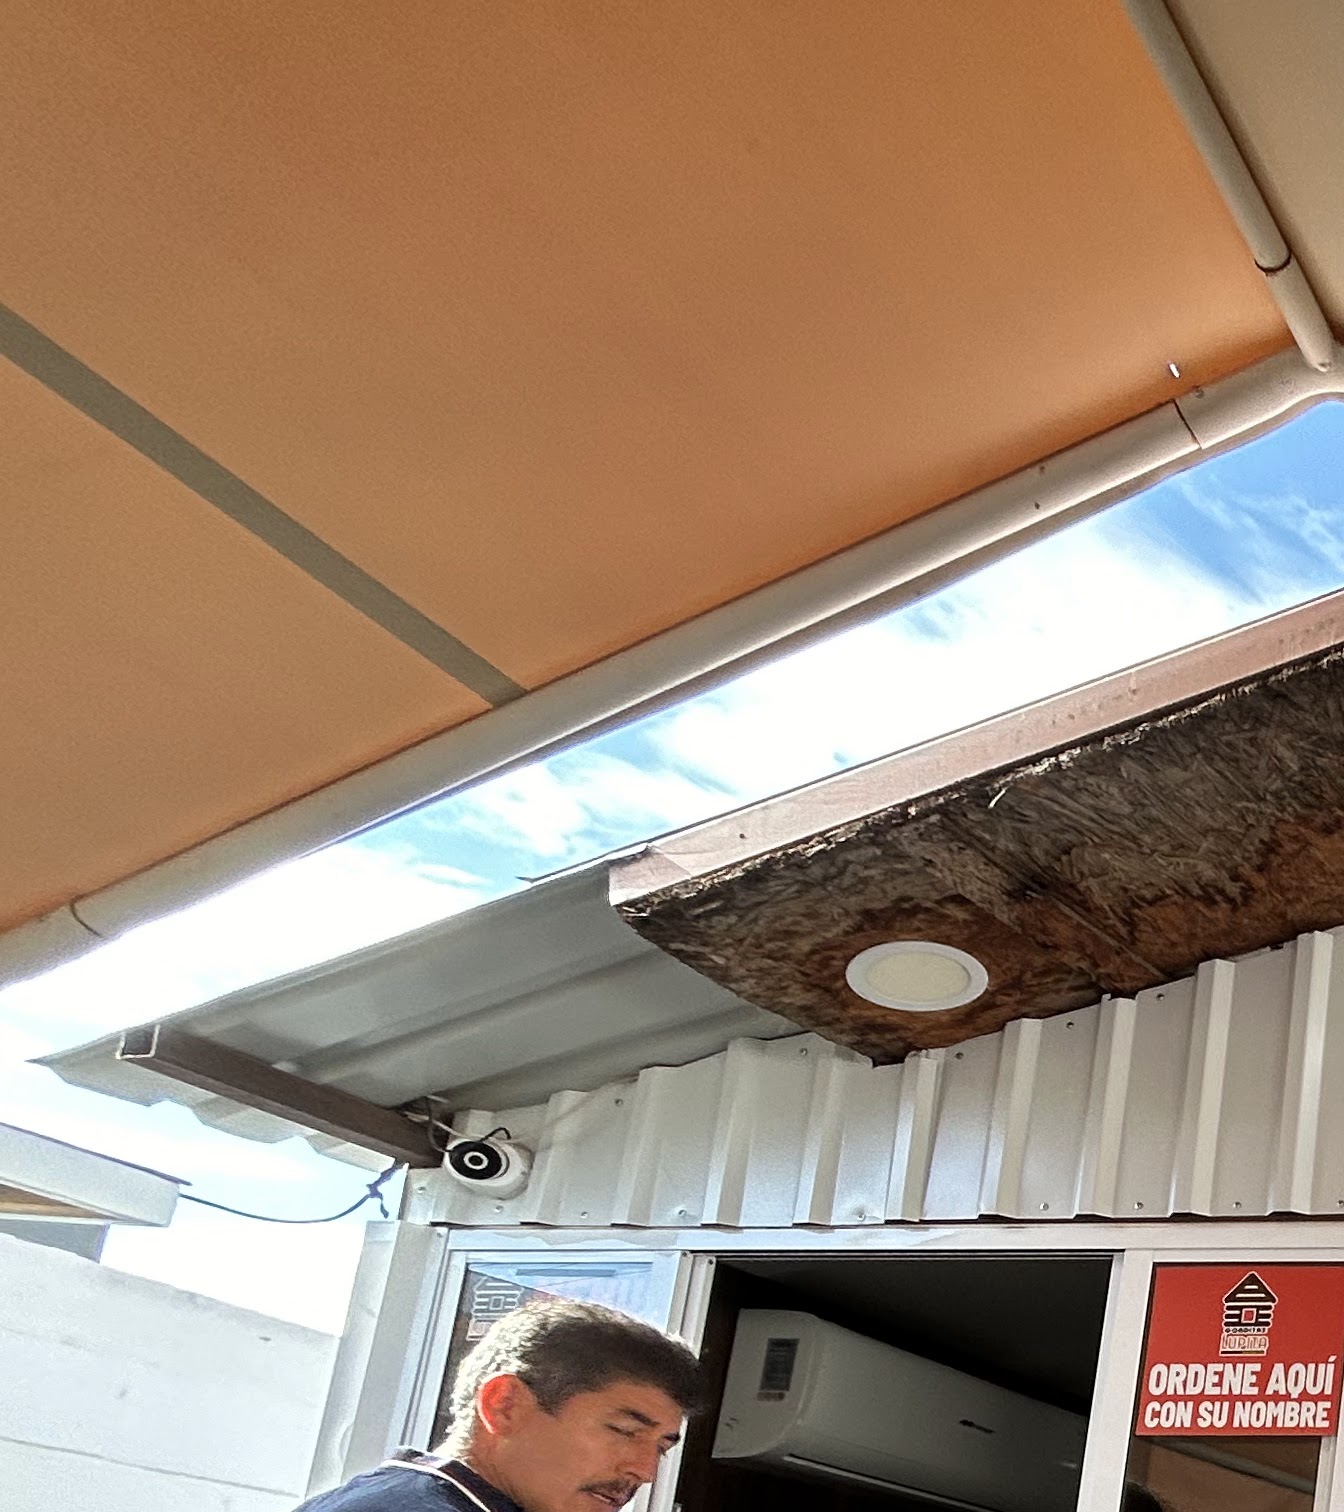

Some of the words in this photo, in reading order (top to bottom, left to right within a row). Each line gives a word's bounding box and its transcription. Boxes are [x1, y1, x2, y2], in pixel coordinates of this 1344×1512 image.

[1221, 1334, 1267, 1350] LUPITA
[1148, 1363, 1262, 1395] ORDENE
[1265, 1355, 1338, 1399] AQUÍ
[1144, 1401, 1193, 1428] CON
[1197, 1401, 1229, 1428] SU
[1232, 1401, 1332, 1428] NOMBRE
